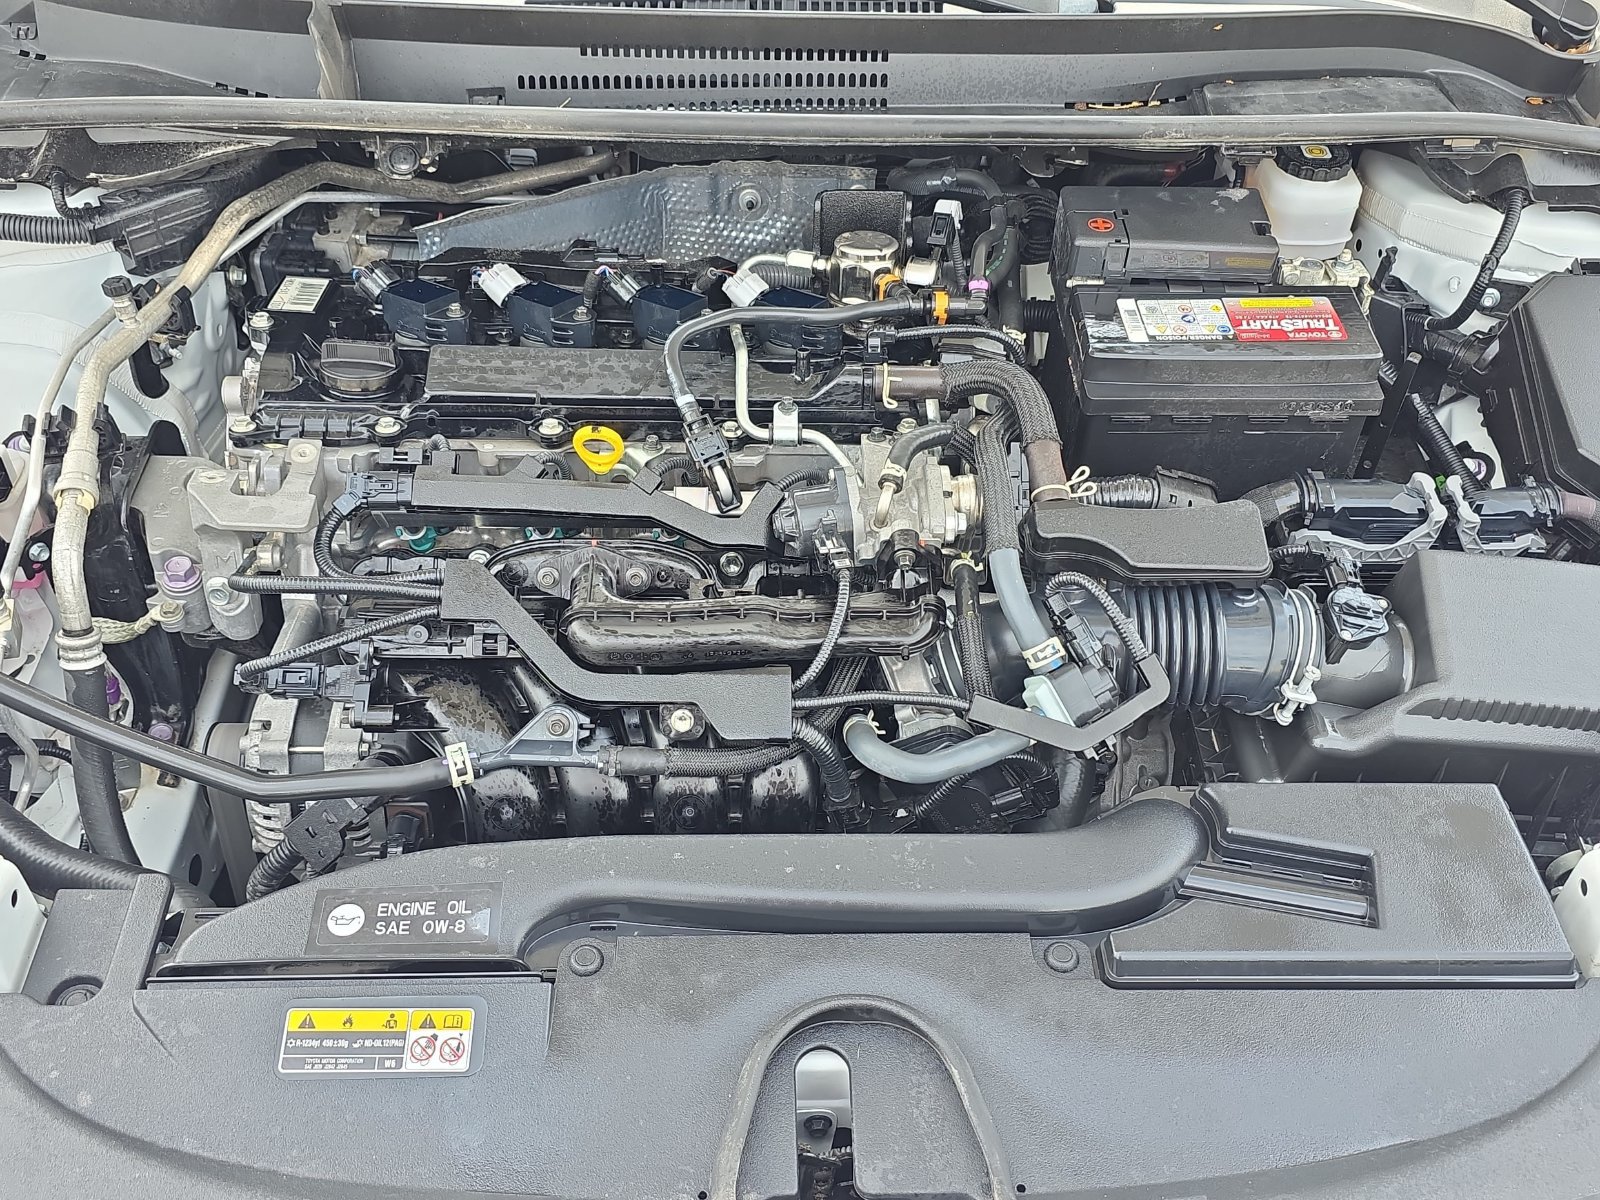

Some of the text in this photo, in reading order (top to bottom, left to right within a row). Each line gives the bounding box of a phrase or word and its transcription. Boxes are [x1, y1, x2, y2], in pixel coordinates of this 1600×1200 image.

[377, 900, 472, 917] ENGINE OIL
[374, 920, 466, 935] SAE 0W-8
